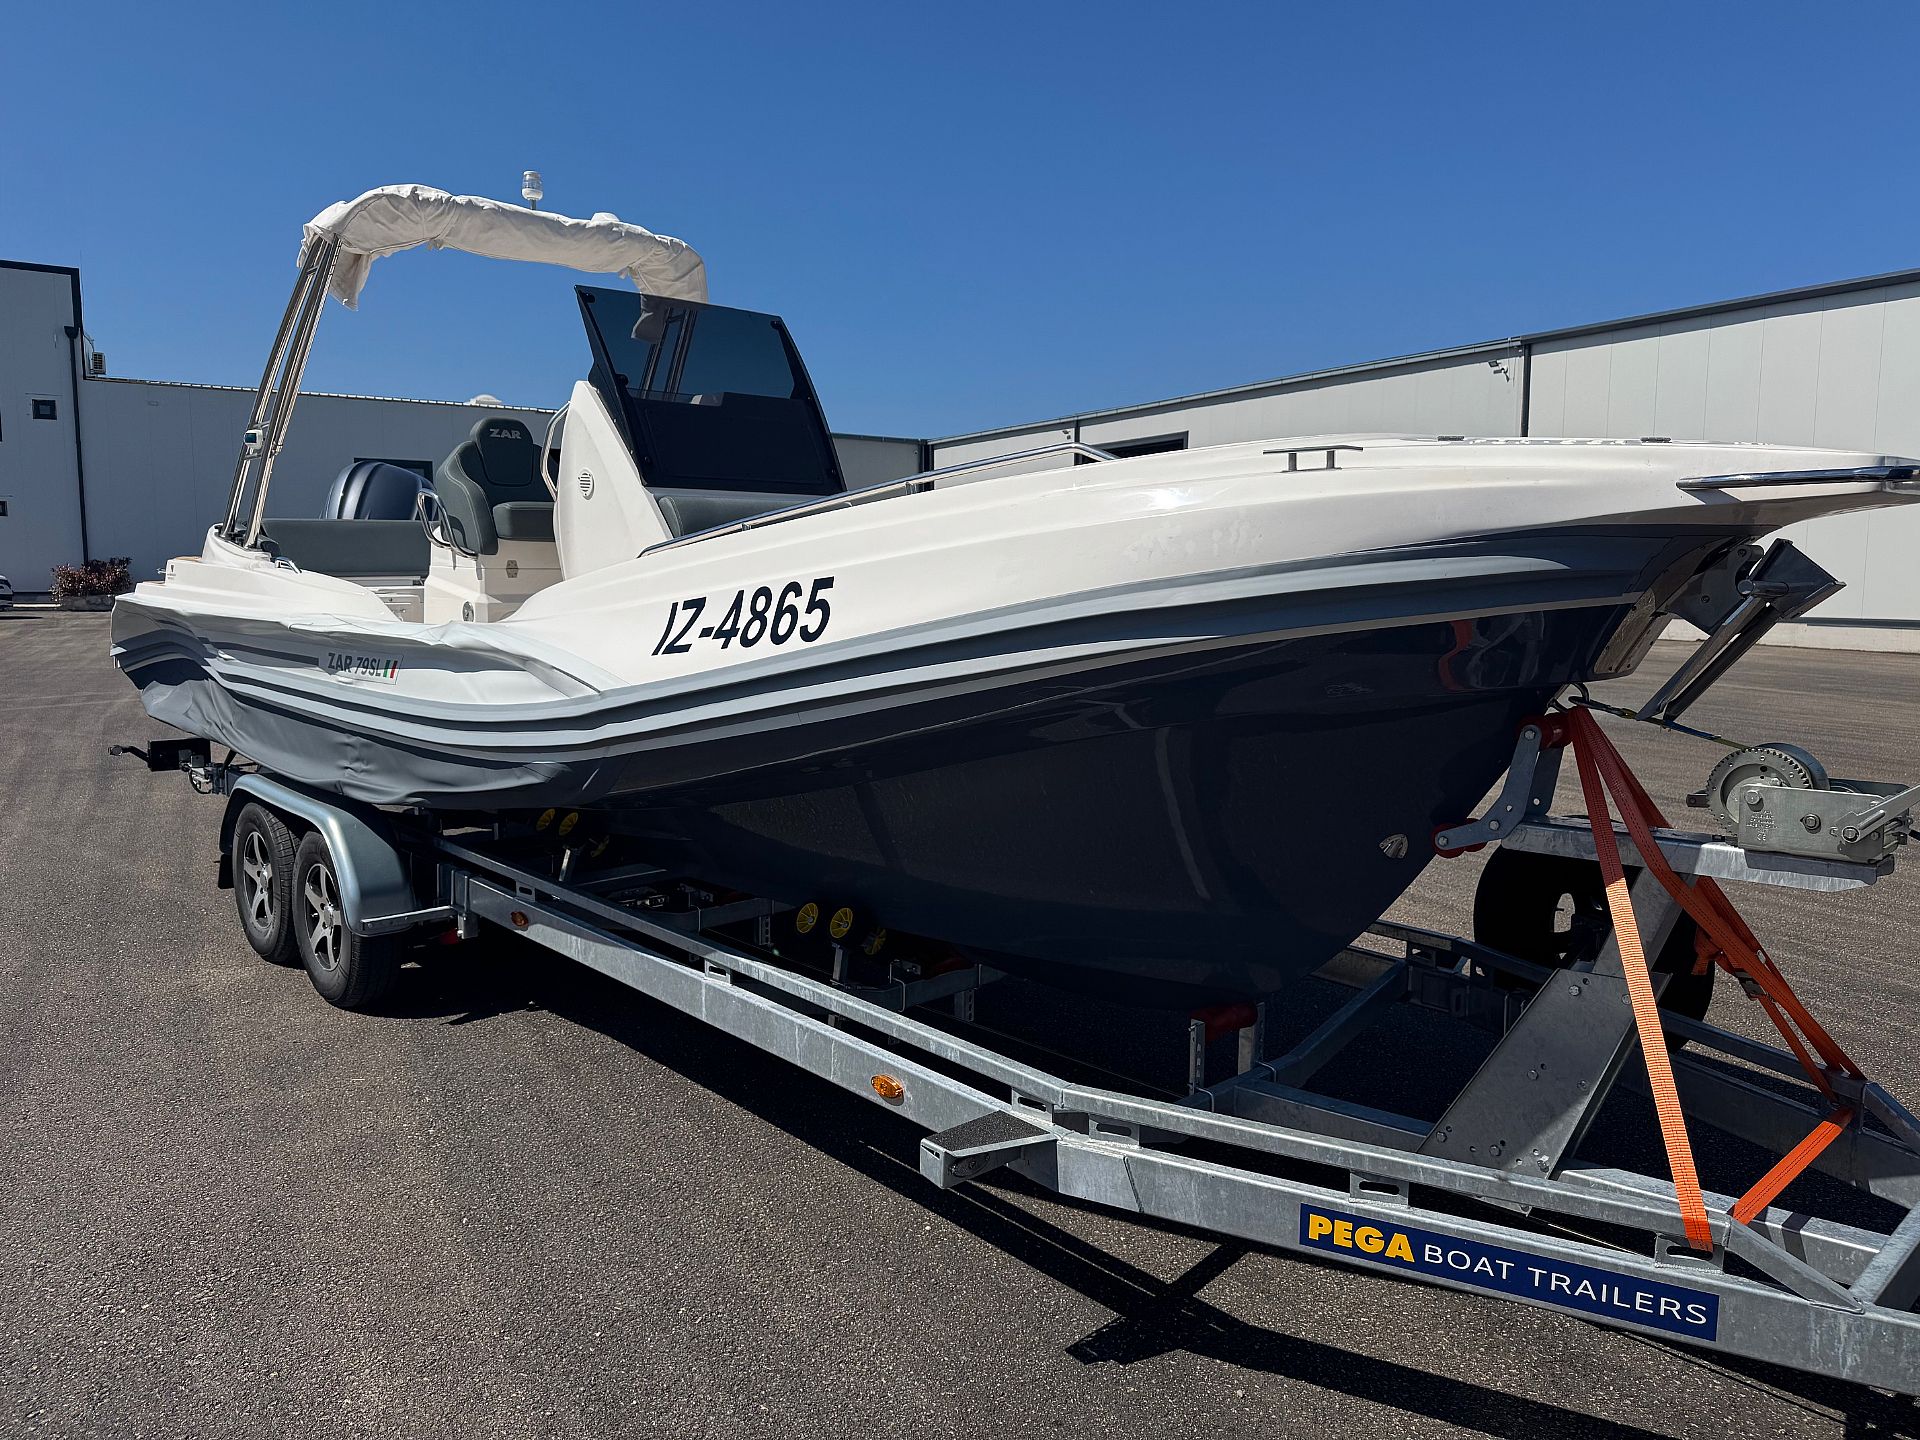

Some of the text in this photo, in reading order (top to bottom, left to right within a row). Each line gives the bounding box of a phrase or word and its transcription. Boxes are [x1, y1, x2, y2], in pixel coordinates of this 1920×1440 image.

[489, 428, 522, 440] ZAR
[651, 576, 835, 656] IZ-4865
[327, 652, 381, 677] ZAR 79SL
[1308, 1213, 1707, 1325] PEGA BOAT TRAILERS
